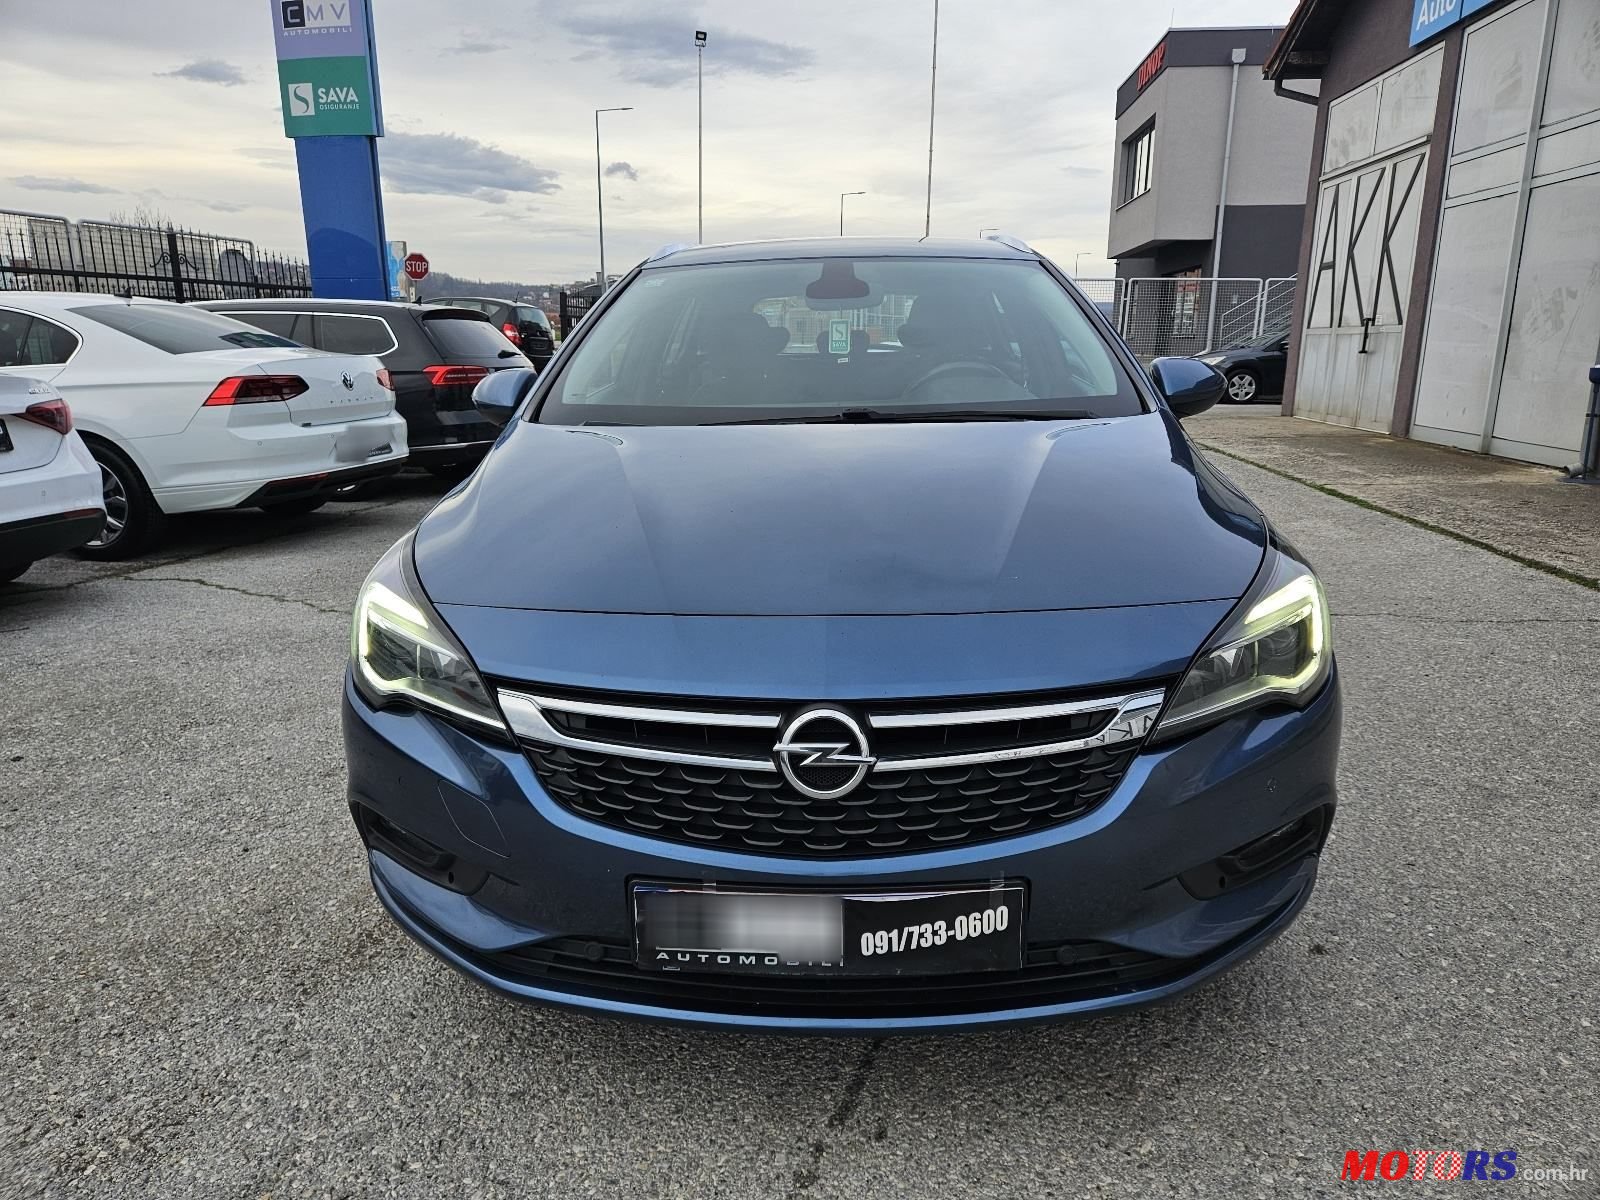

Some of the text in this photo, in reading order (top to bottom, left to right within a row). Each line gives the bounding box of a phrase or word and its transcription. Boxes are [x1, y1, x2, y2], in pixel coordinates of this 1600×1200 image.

[283, 26, 353, 37] AUTOMOBILI
[317, 86, 359, 104] SAVA
[319, 103, 361, 111] OSIGURANJE
[1306, 151, 1428, 330] AKK
[405, 260, 428, 273] STOP
[860, 905, 1009, 957] 091/733-0600
